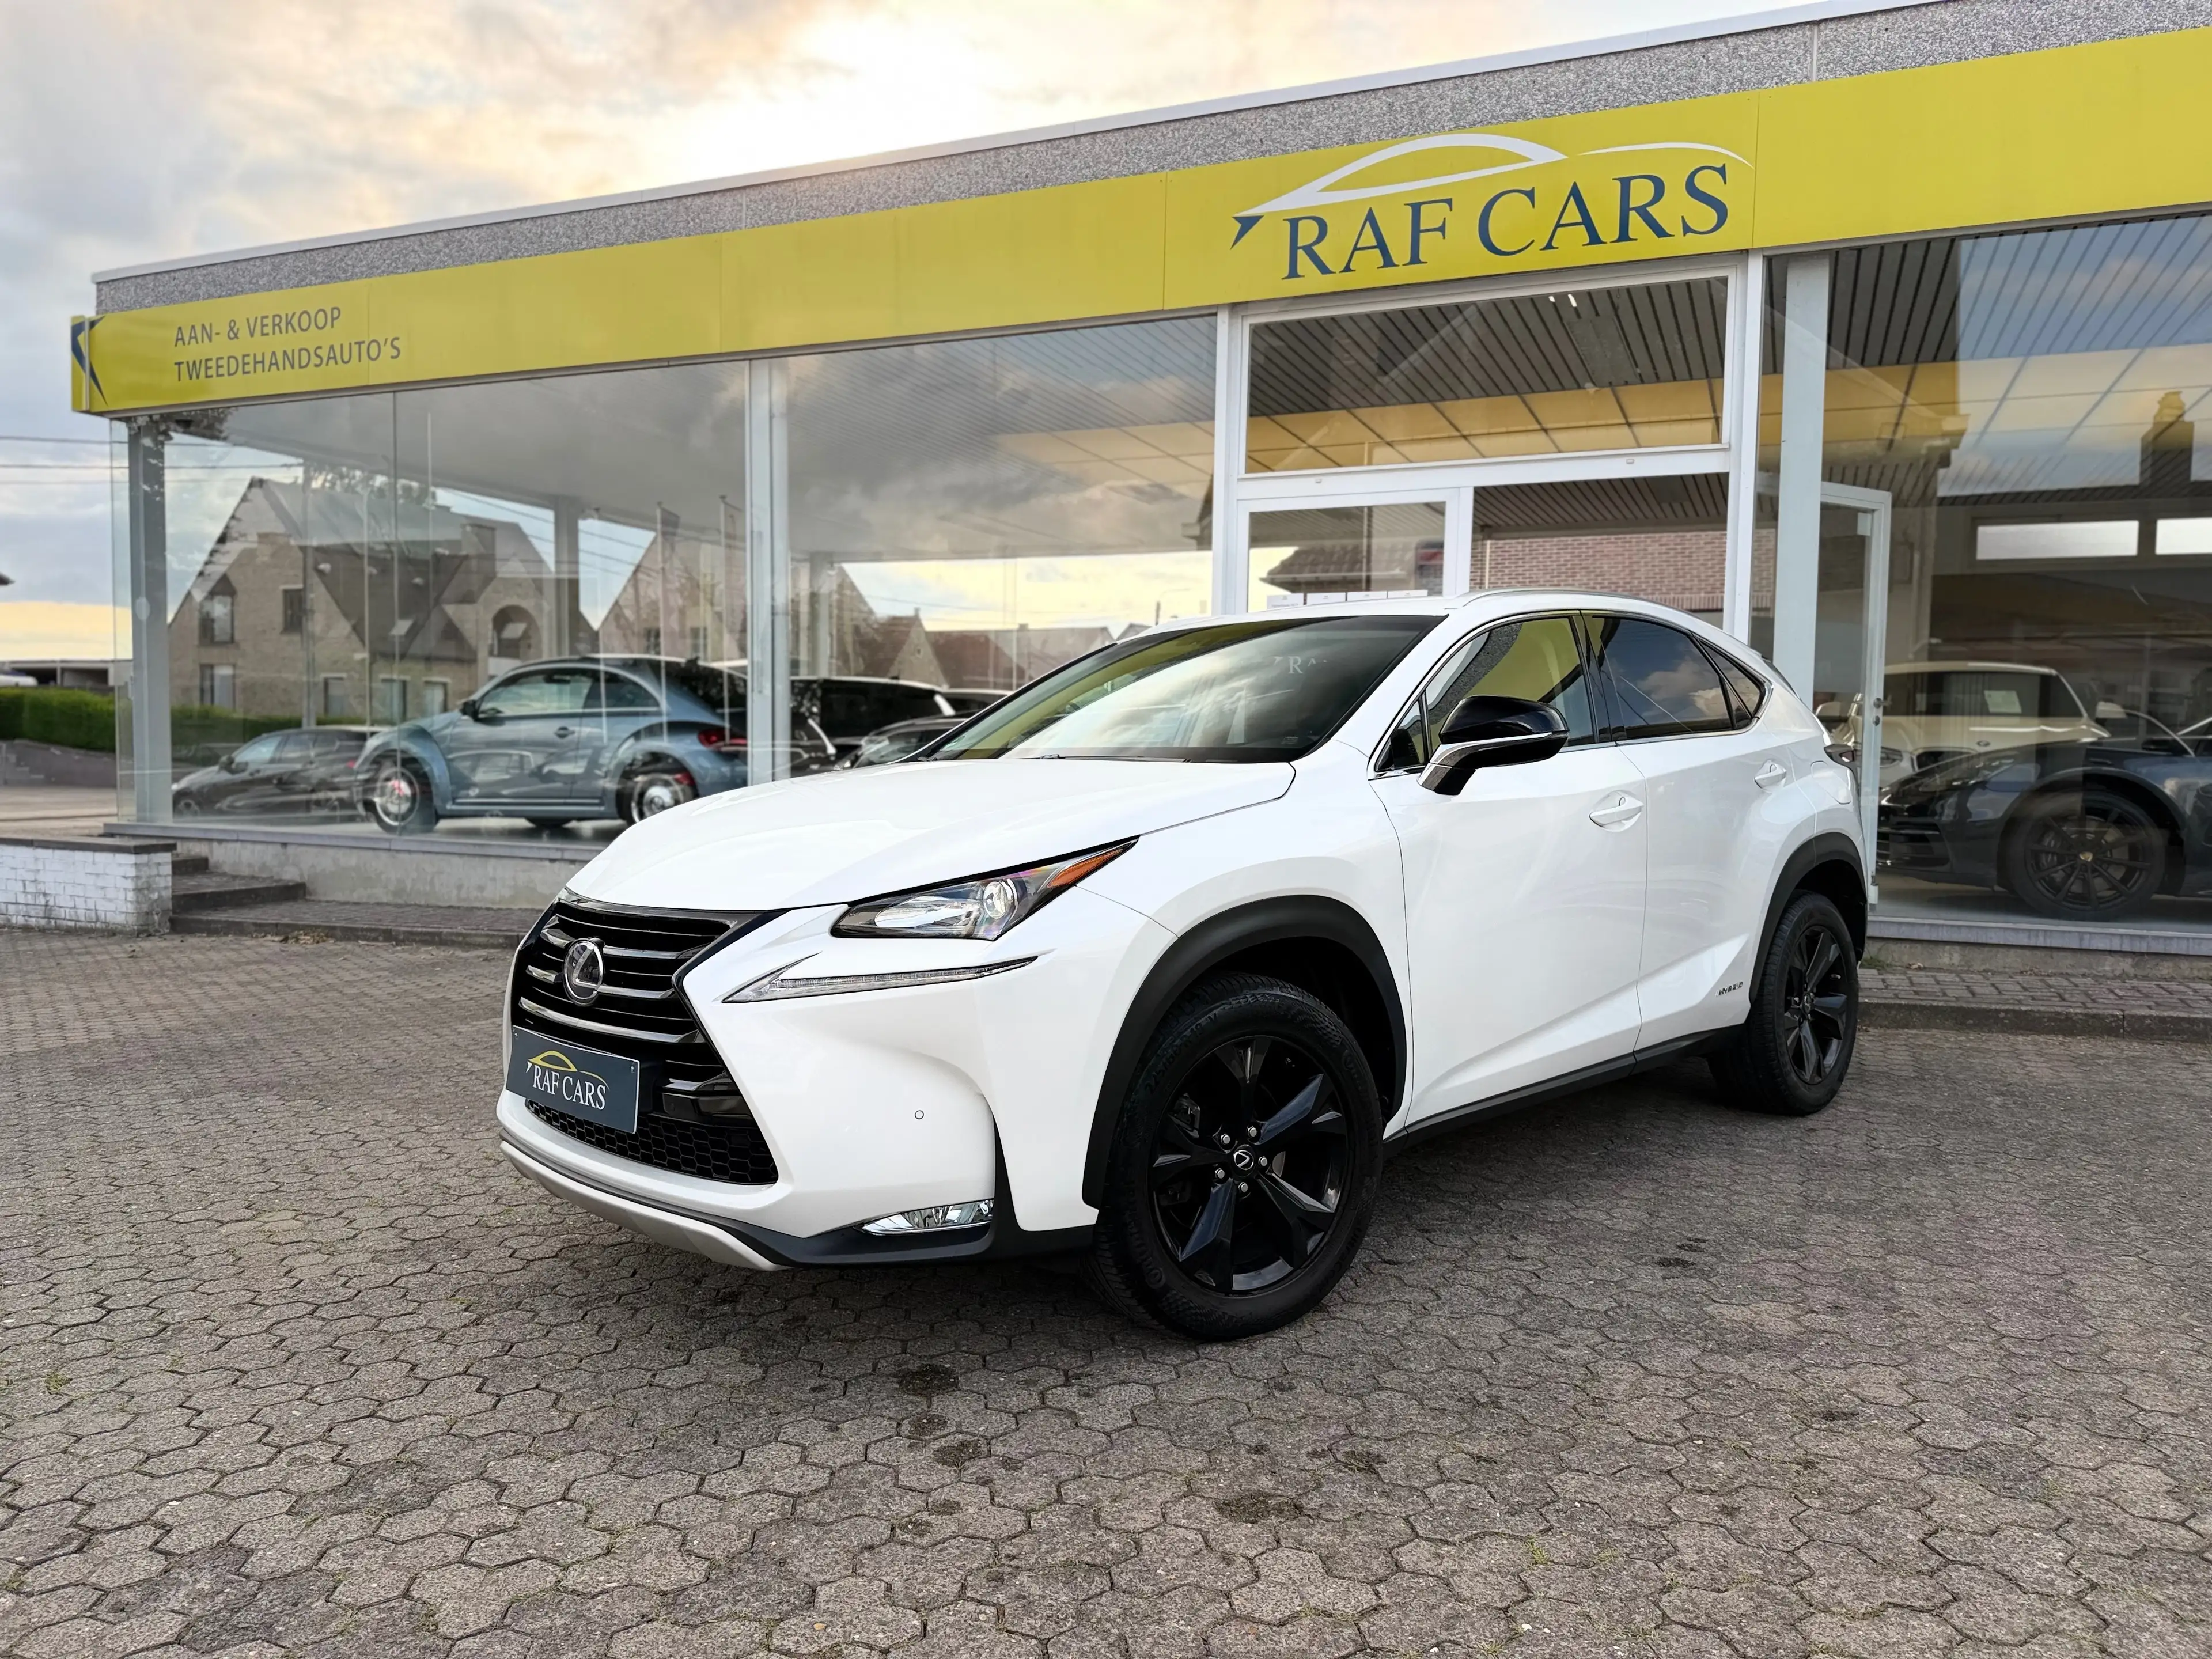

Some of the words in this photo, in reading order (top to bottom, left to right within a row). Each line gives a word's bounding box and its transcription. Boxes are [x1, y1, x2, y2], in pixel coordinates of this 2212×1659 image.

[1281, 198, 1453, 281] RAF
[1478, 162, 1728, 256] CARS
[174, 323, 221, 347] AAN-
[227, 319, 240, 341] &
[246, 306, 341, 339] VERKOOP
[532, 1065, 560, 1095] RAF
[562, 1075, 606, 1111] CARS
